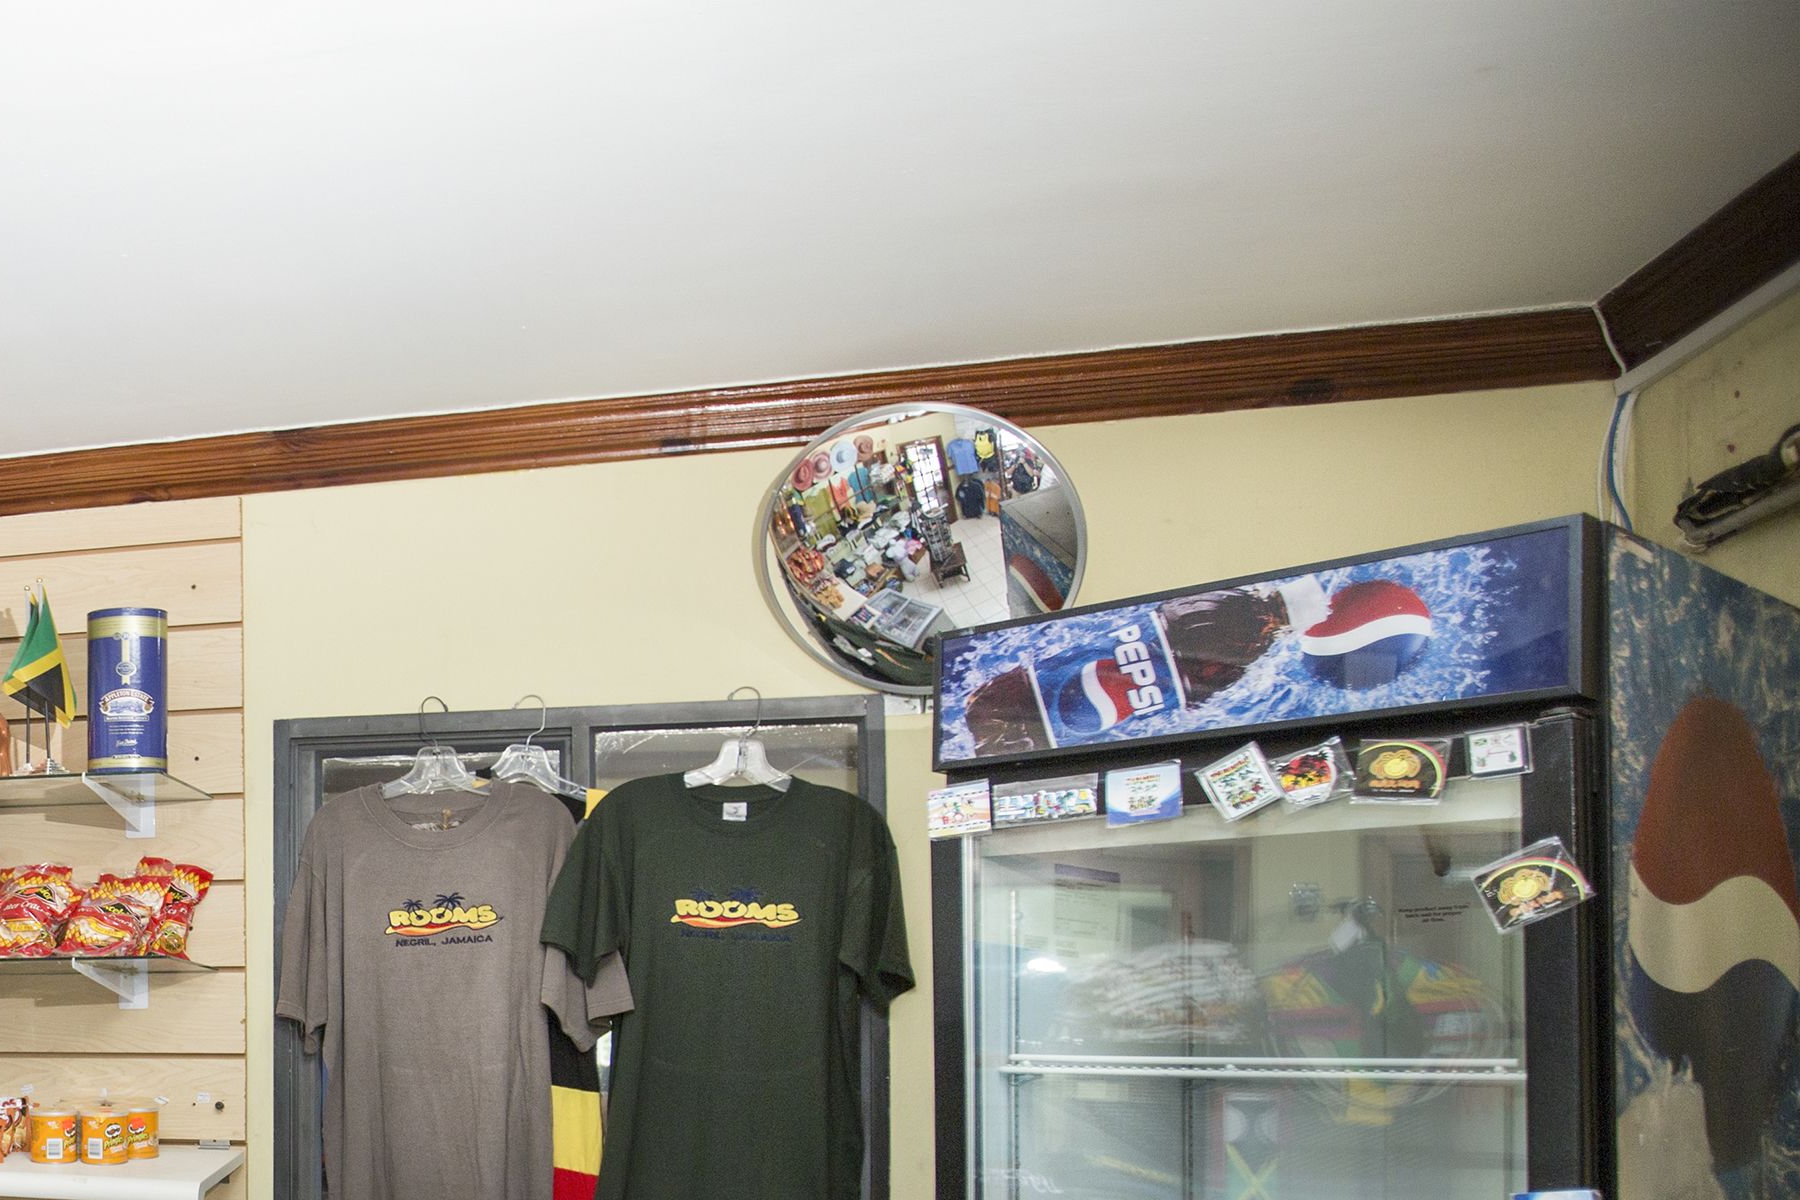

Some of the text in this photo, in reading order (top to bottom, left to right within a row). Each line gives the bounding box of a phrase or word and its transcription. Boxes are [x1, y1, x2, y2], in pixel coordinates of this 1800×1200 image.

[1109, 625, 1163, 716] PEPSI
[389, 904, 498, 928] ROOMS
[675, 898, 800, 923] ROOMS
[395, 934, 493, 948] NEGRIL, JAMAICA
